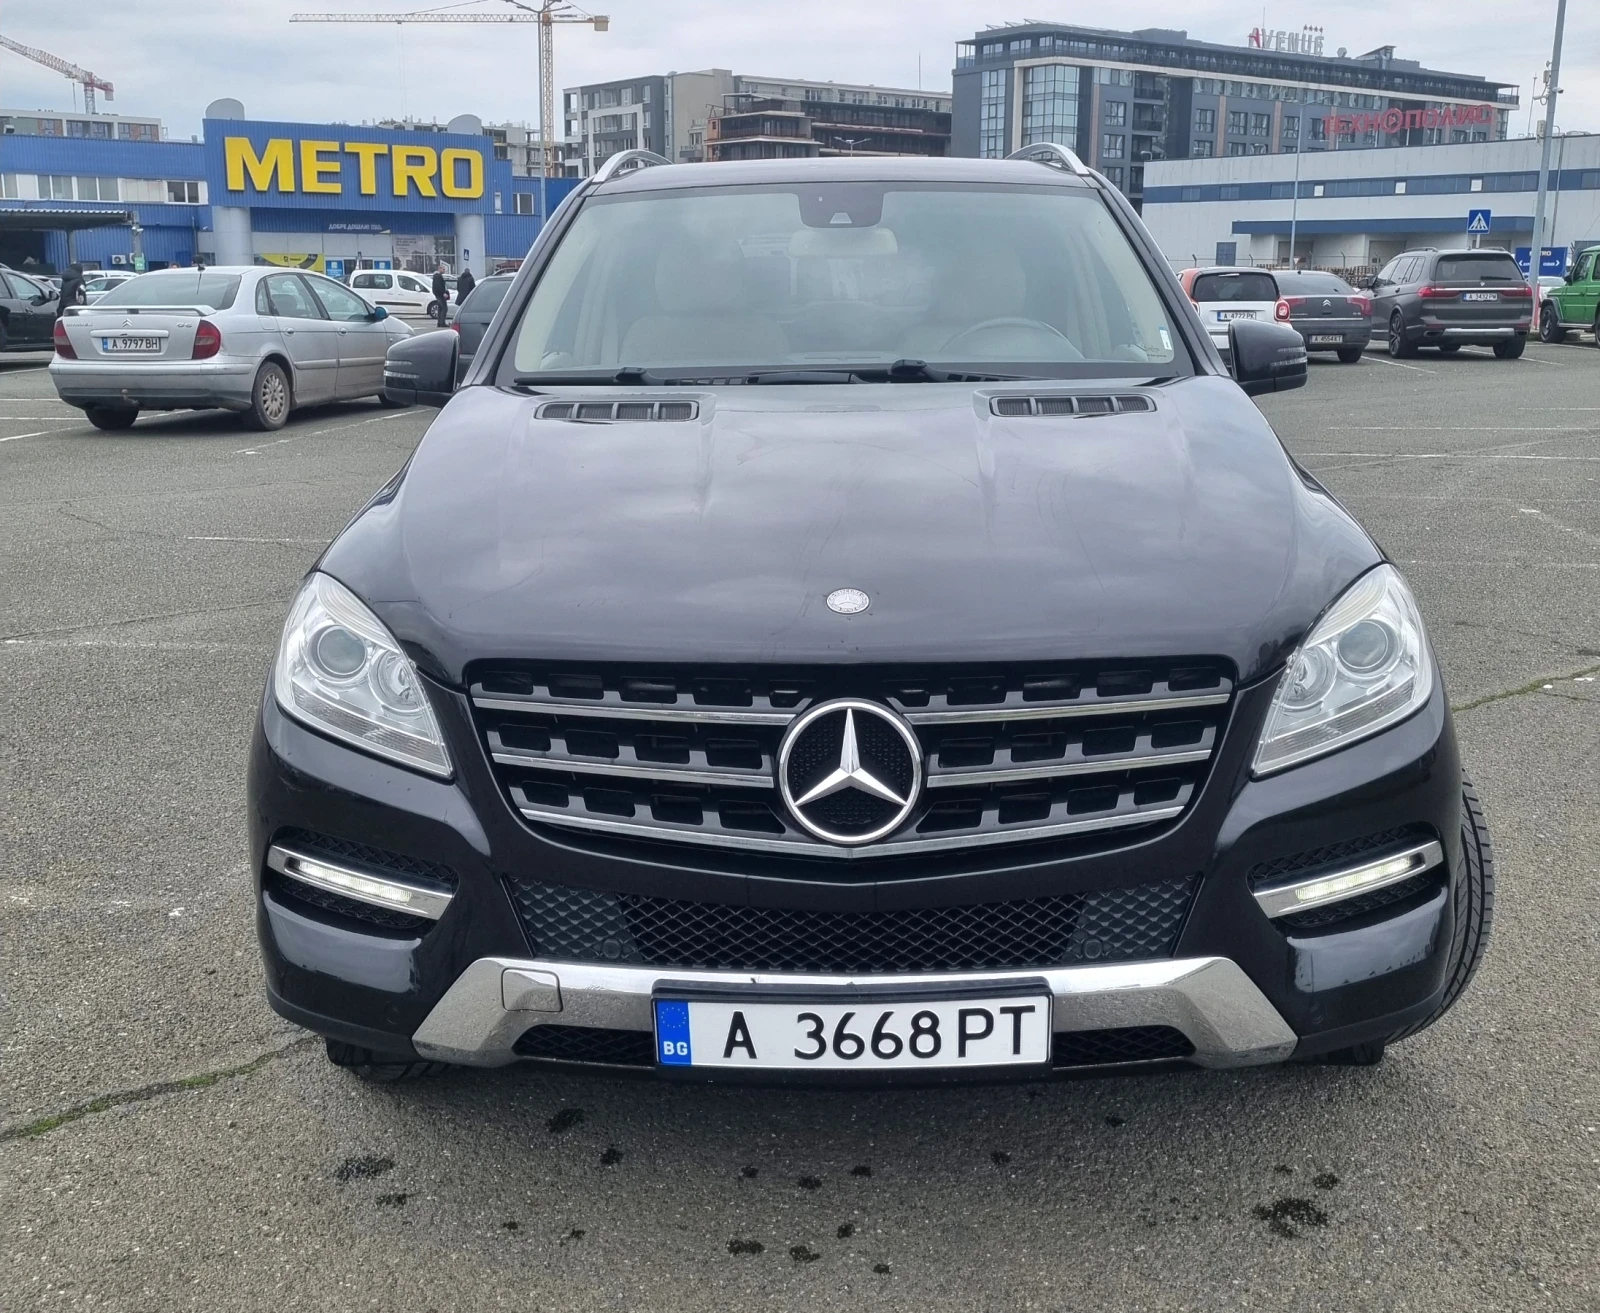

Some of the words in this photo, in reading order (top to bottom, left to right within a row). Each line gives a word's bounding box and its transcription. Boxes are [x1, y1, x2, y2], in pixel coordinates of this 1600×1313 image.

[1247, 27, 1324, 56] AVENUE
[1322, 104, 1493, 135] ТЕХНОПОЛИС
[224, 136, 483, 198] METRO
[663, 1041, 688, 1056] BG
